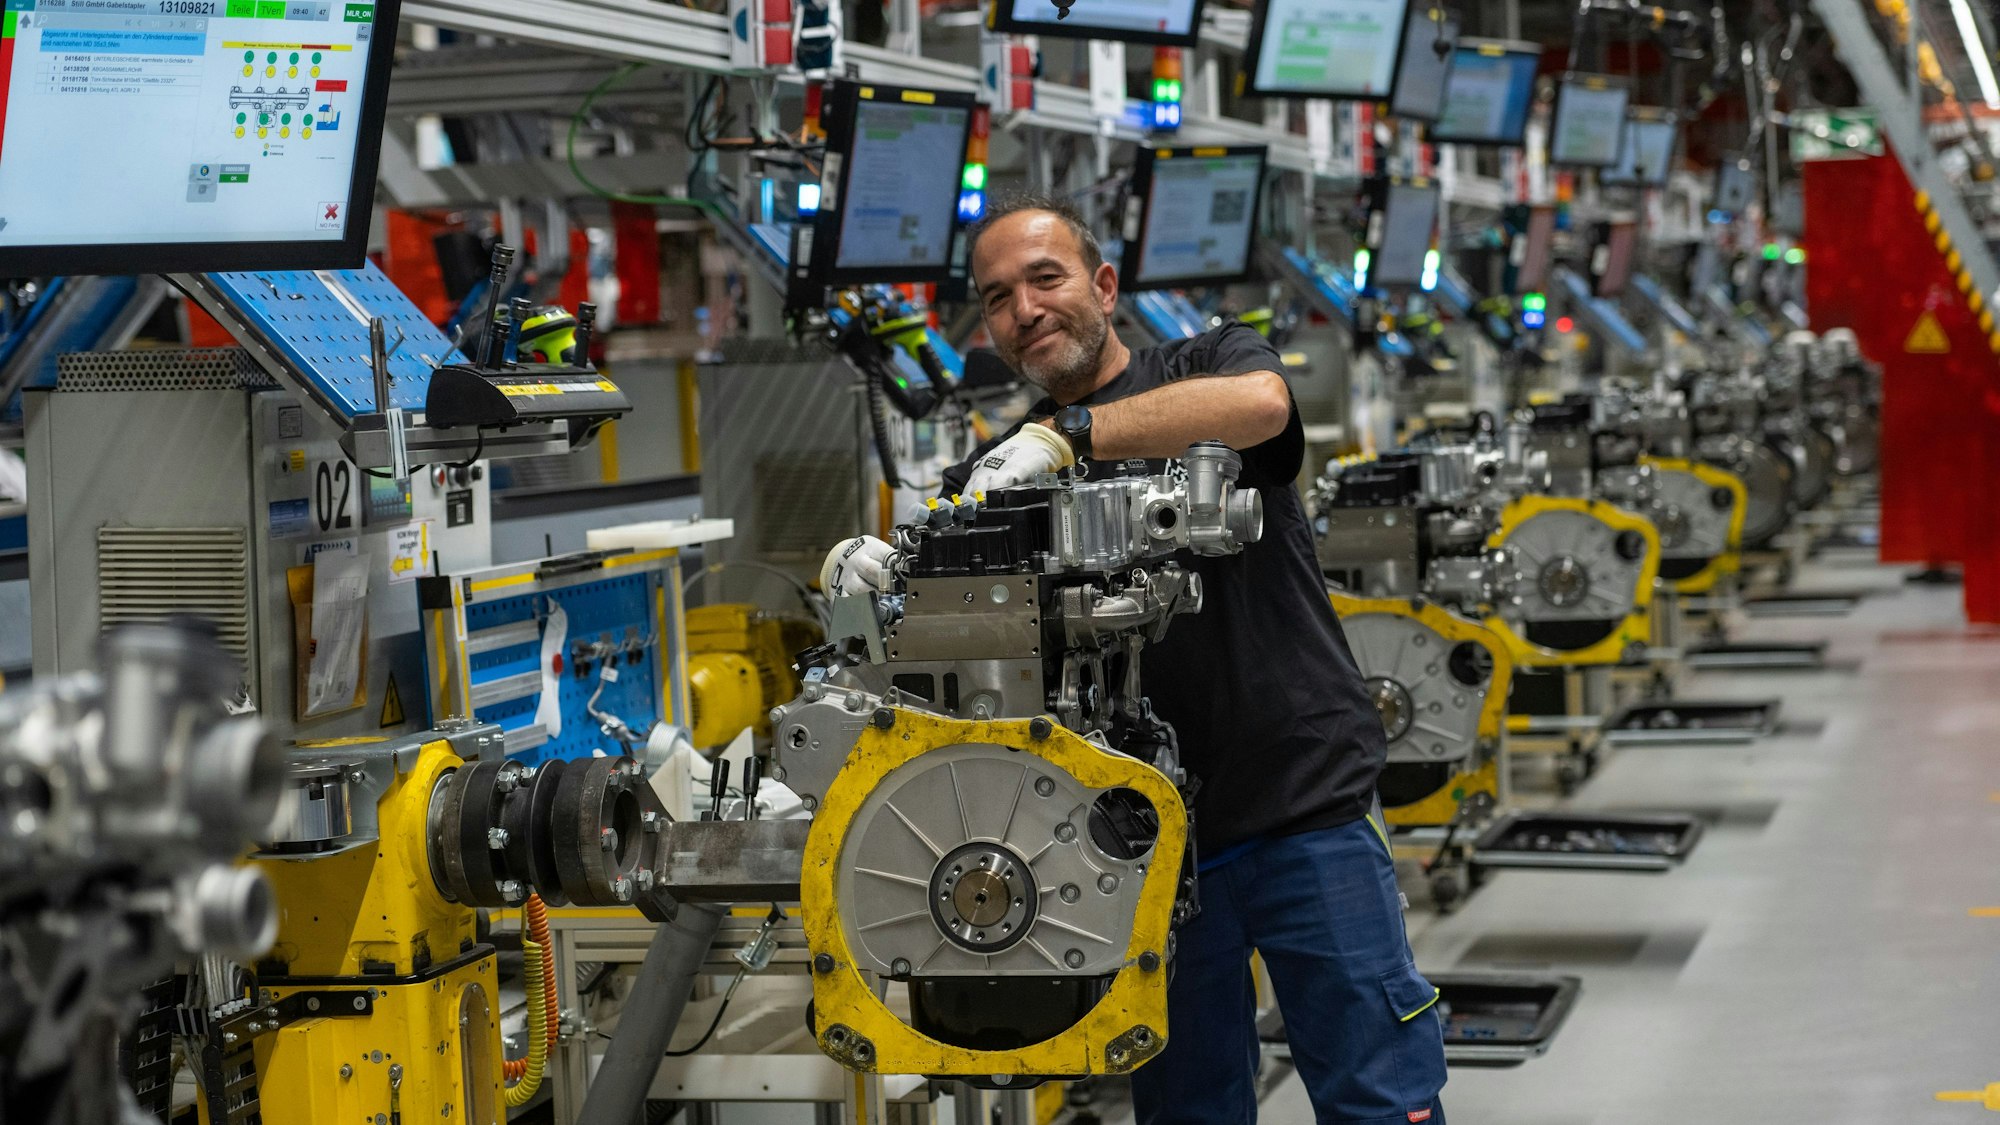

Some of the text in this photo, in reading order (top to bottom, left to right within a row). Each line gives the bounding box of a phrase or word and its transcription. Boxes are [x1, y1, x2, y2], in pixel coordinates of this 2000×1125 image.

[106, 1, 146, 9] Gabelstapler
[159, 1, 215, 14] 13109821
[232, 5, 250, 14] Teile
[261, 6, 281, 15] TVen
[346, 10, 372, 18] MLR_ON
[316, 460, 351, 532] 02
